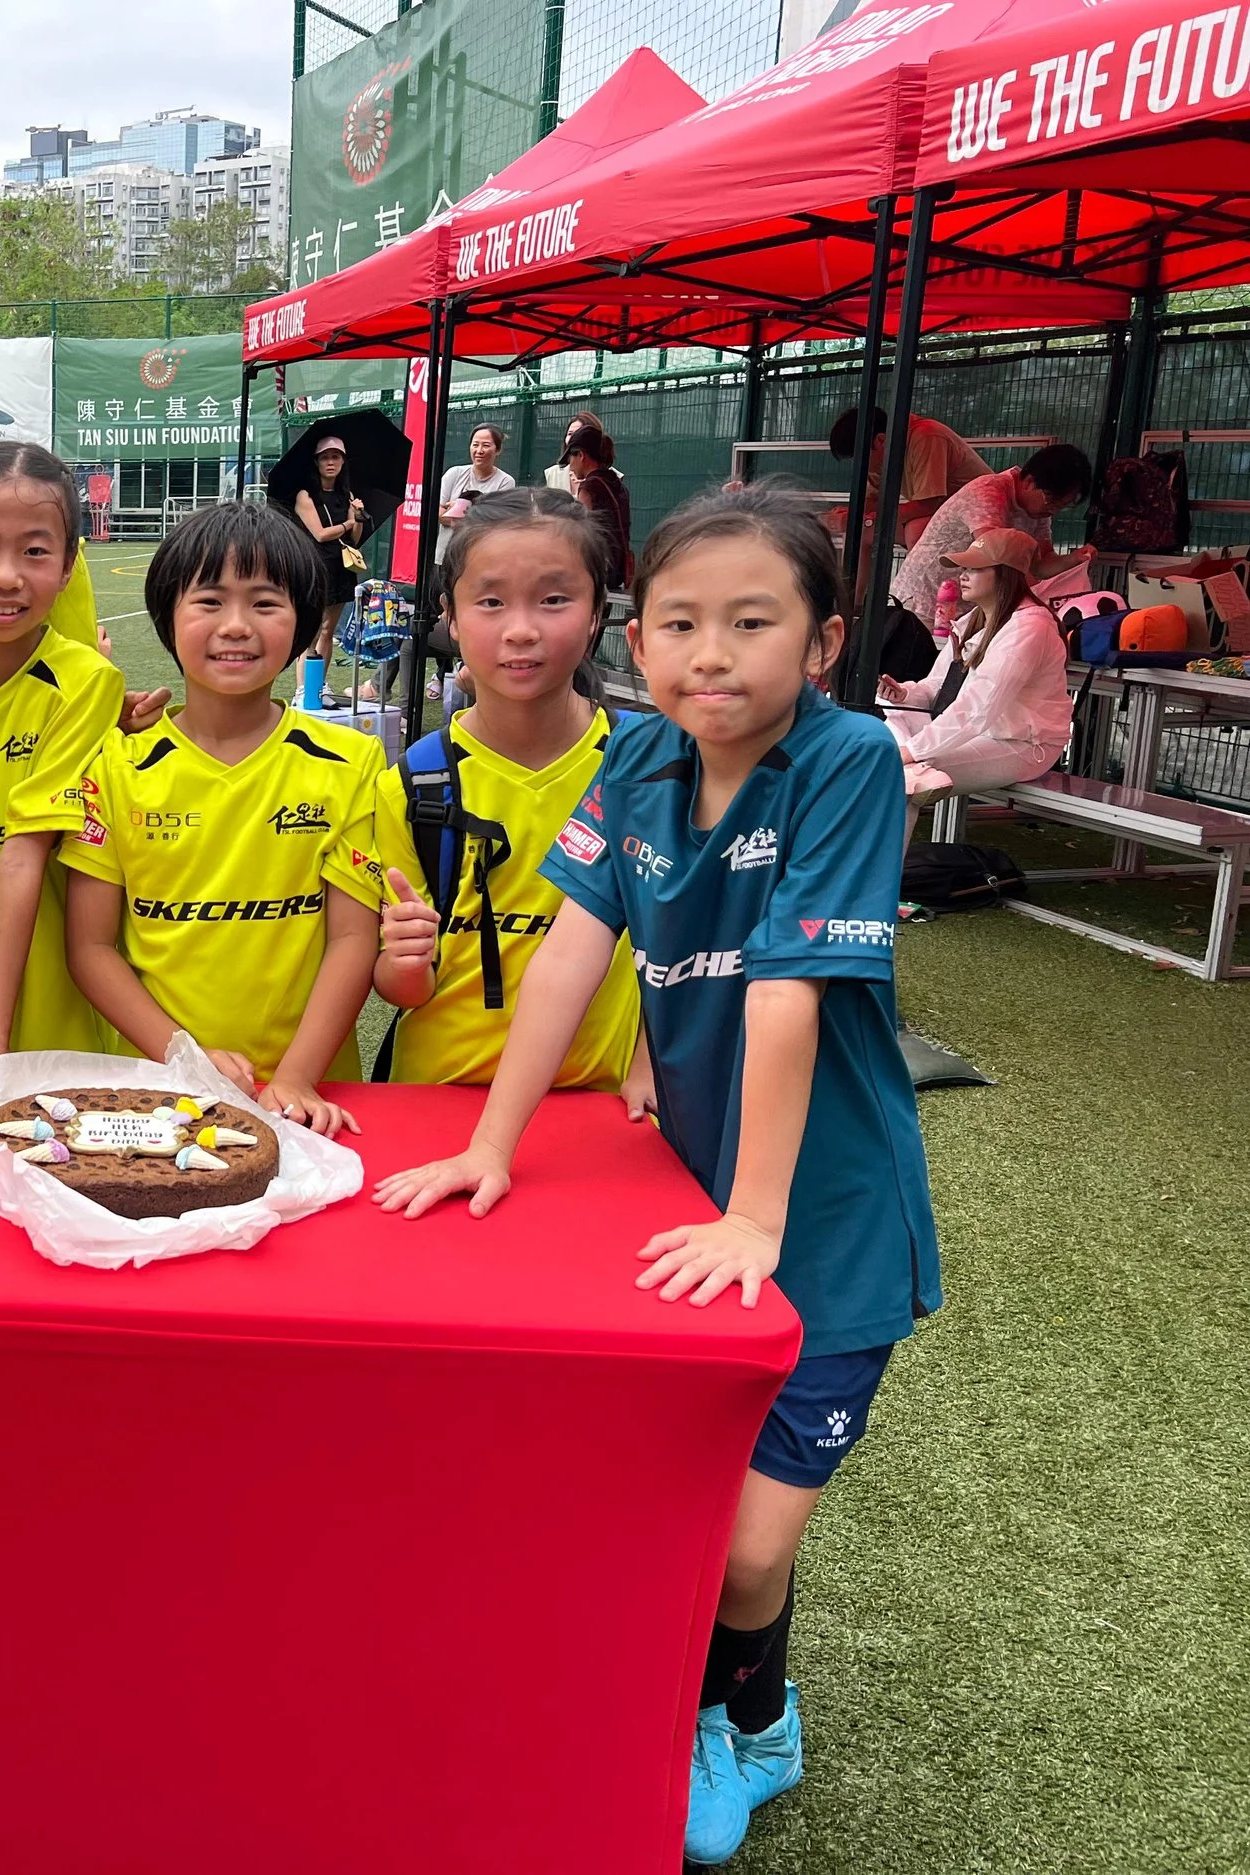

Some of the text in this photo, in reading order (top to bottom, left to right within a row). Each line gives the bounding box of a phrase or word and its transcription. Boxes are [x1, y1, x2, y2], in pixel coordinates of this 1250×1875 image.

[946, 5, 1250, 163] WE THE FUTU
[456, 231, 483, 281] WE
[485, 220, 516, 275] THE
[514, 199, 584, 267] FUTURE
[248, 298, 308, 351] WE THE FUTURE
[77, 396, 253, 422] 陳守仁基金會
[78, 429, 101, 446] TAN
[106, 428, 129, 446] SIU
[134, 428, 156, 446] LIN
[130, 810, 201, 828] OBSE
[133, 888, 325, 921] SKECHERS
[827, 919, 894, 938] GO24
